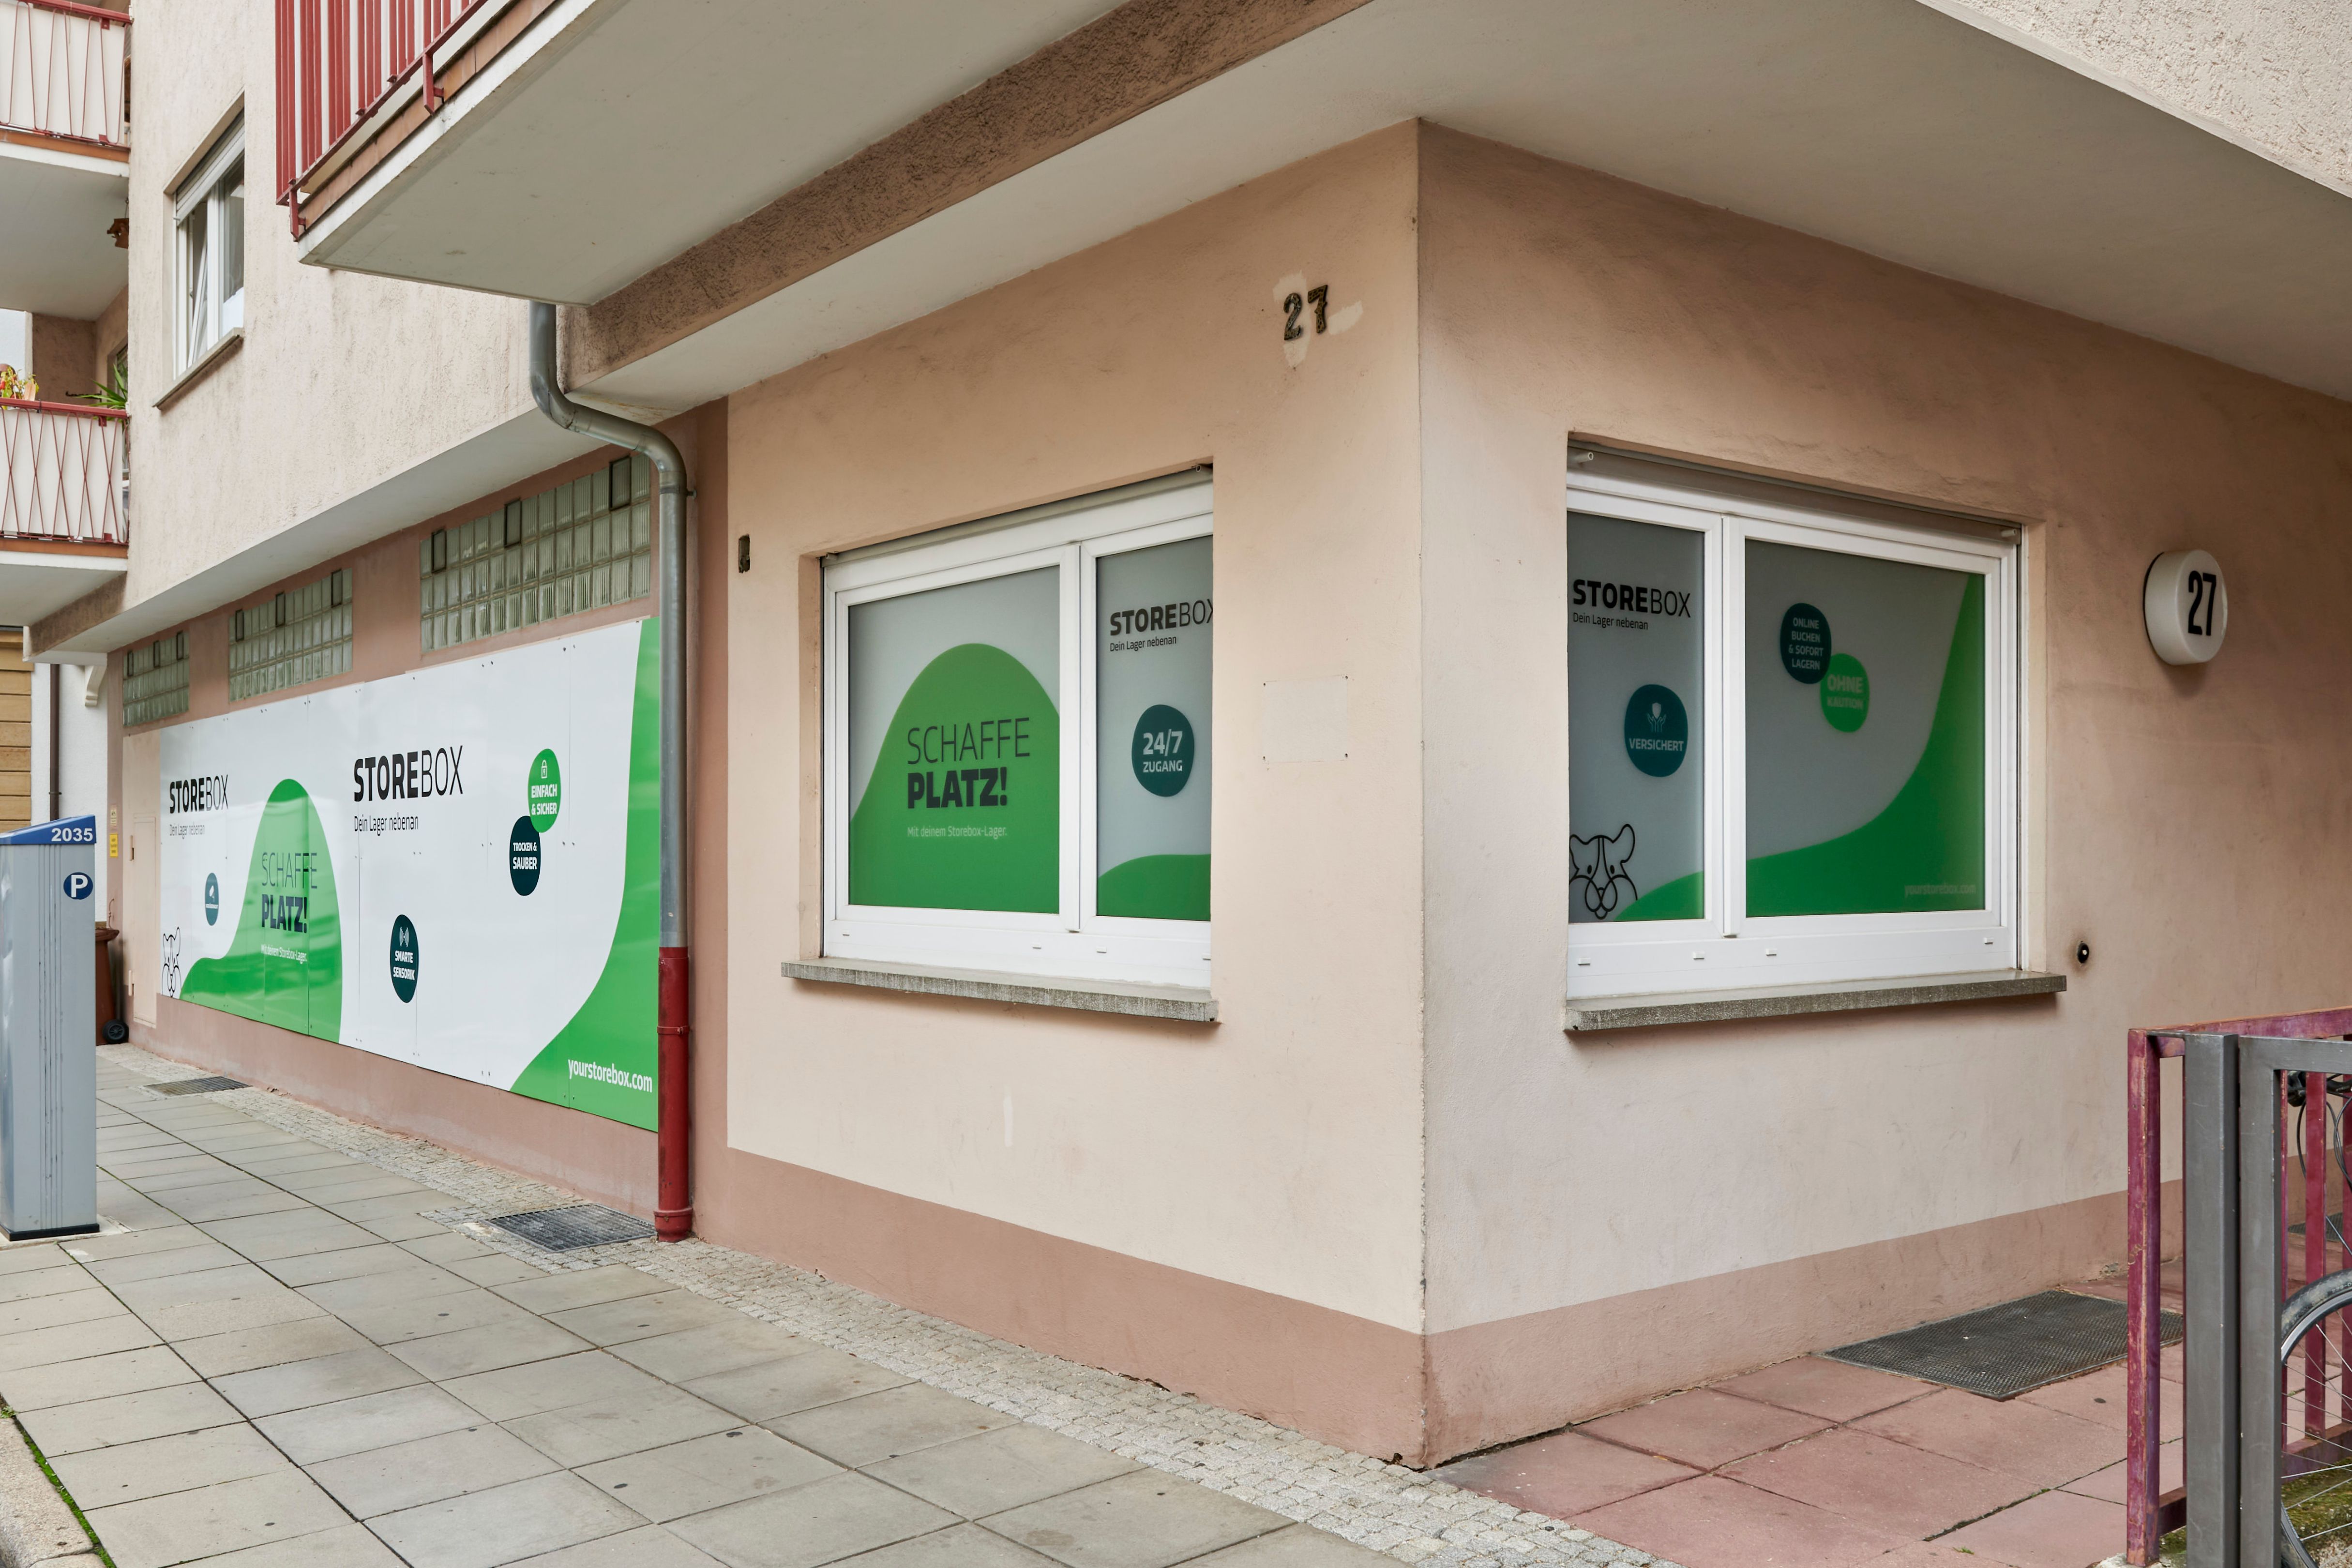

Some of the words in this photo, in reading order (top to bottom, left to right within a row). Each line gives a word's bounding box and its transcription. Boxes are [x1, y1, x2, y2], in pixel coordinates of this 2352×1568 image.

[1283, 285, 1328, 340] 27
[1573, 579, 1690, 618] STOREBOX
[2188, 571, 2216, 636] 27
[1573, 612, 1590, 623] Dein
[1593, 615, 1614, 628] Lager
[1616, 617, 1648, 630] nebenan
[1793, 618, 1819, 629] ONLINE
[1110, 641, 1124, 651] Dein
[1127, 641, 1145, 651] Lager
[1147, 636, 1176, 647] nebenan
[1792, 631, 1820, 642] BUCHEN
[1788, 644, 1794, 653] &
[1795, 645, 1824, 656] SOFORT
[1792, 658, 1820, 670] LAGERN
[1827, 674, 1863, 693] OHNE
[1827, 696, 1863, 709] KAUTION
[908, 717, 1030, 764] SCHAFFE
[1143, 729, 1183, 756] 24/7
[1629, 738, 1684, 751] VERSICHERT
[354, 745, 463, 802] STOREBOX
[1143, 760, 1182, 772] ZUGANG
[170, 774, 228, 814] STOREBOX
[531, 784, 558, 798] EINFACH
[908, 767, 1007, 809] PLATZ!
[531, 803, 536, 815] &
[537, 802, 557, 815] SICHER
[354, 814, 367, 831] Dein
[369, 815, 387, 836] Lager
[390, 812, 418, 830] nebenan
[51, 828, 93, 842] 2035
[907, 826, 919, 837] Mit
[920, 825, 946, 837] deinem
[948, 825, 1008, 840] Storebox-Lager.
[513, 843, 533, 851] TROCKEN
[533, 842, 537, 851] &
[262, 852, 317, 889] SCHAFFE
[513, 857, 537, 869] SAUBER
[71, 874, 88, 897] P
[262, 894, 307, 934] PLATZ!
[395, 950, 413, 963] SMARTE
[393, 966, 415, 980] SENSORIK
[568, 1059, 652, 1093] yourstorebox.com
